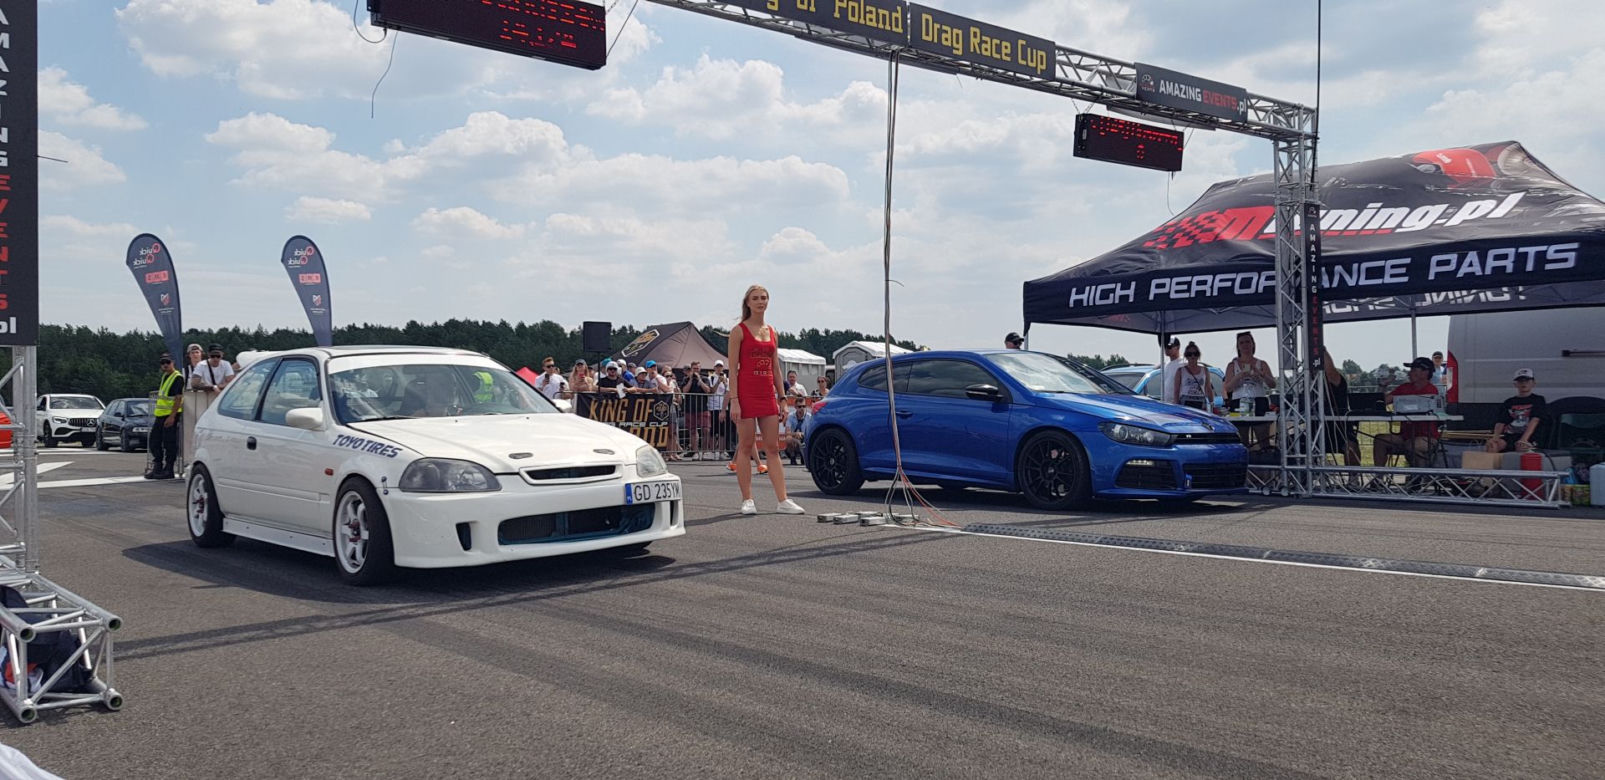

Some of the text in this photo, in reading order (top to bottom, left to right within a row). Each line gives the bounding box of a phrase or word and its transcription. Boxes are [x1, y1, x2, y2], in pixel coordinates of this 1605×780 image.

[833, 0, 904, 33] Poland
[921, 13, 1047, 75] Drag Race Cup
[1068, 281, 1137, 308] HIGH
[1428, 242, 1580, 281] PARTS
[589, 398, 655, 422] KING OF
[634, 484, 651, 501] GD
